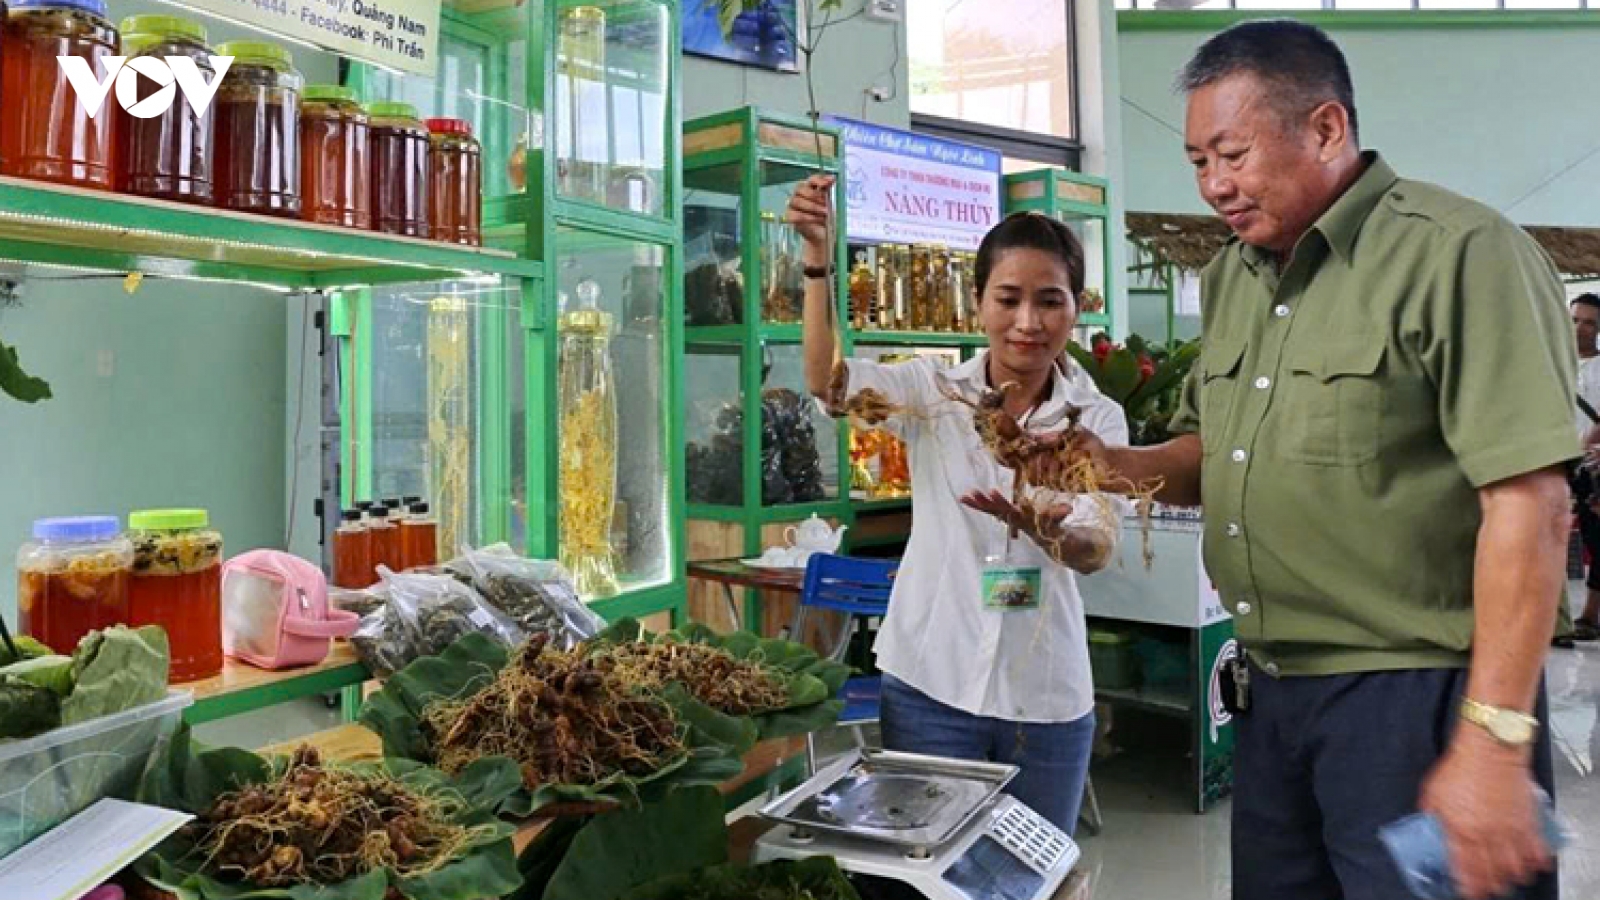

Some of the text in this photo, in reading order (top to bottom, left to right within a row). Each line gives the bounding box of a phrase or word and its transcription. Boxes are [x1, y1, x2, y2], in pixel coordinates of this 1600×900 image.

[300, 5, 369, 41] Facebook:
[373, 30, 394, 51] Phi
[396, 37, 425, 60] Trần
[353, 0, 394, 30] Quảng
[398, 14, 427, 36] Nam
